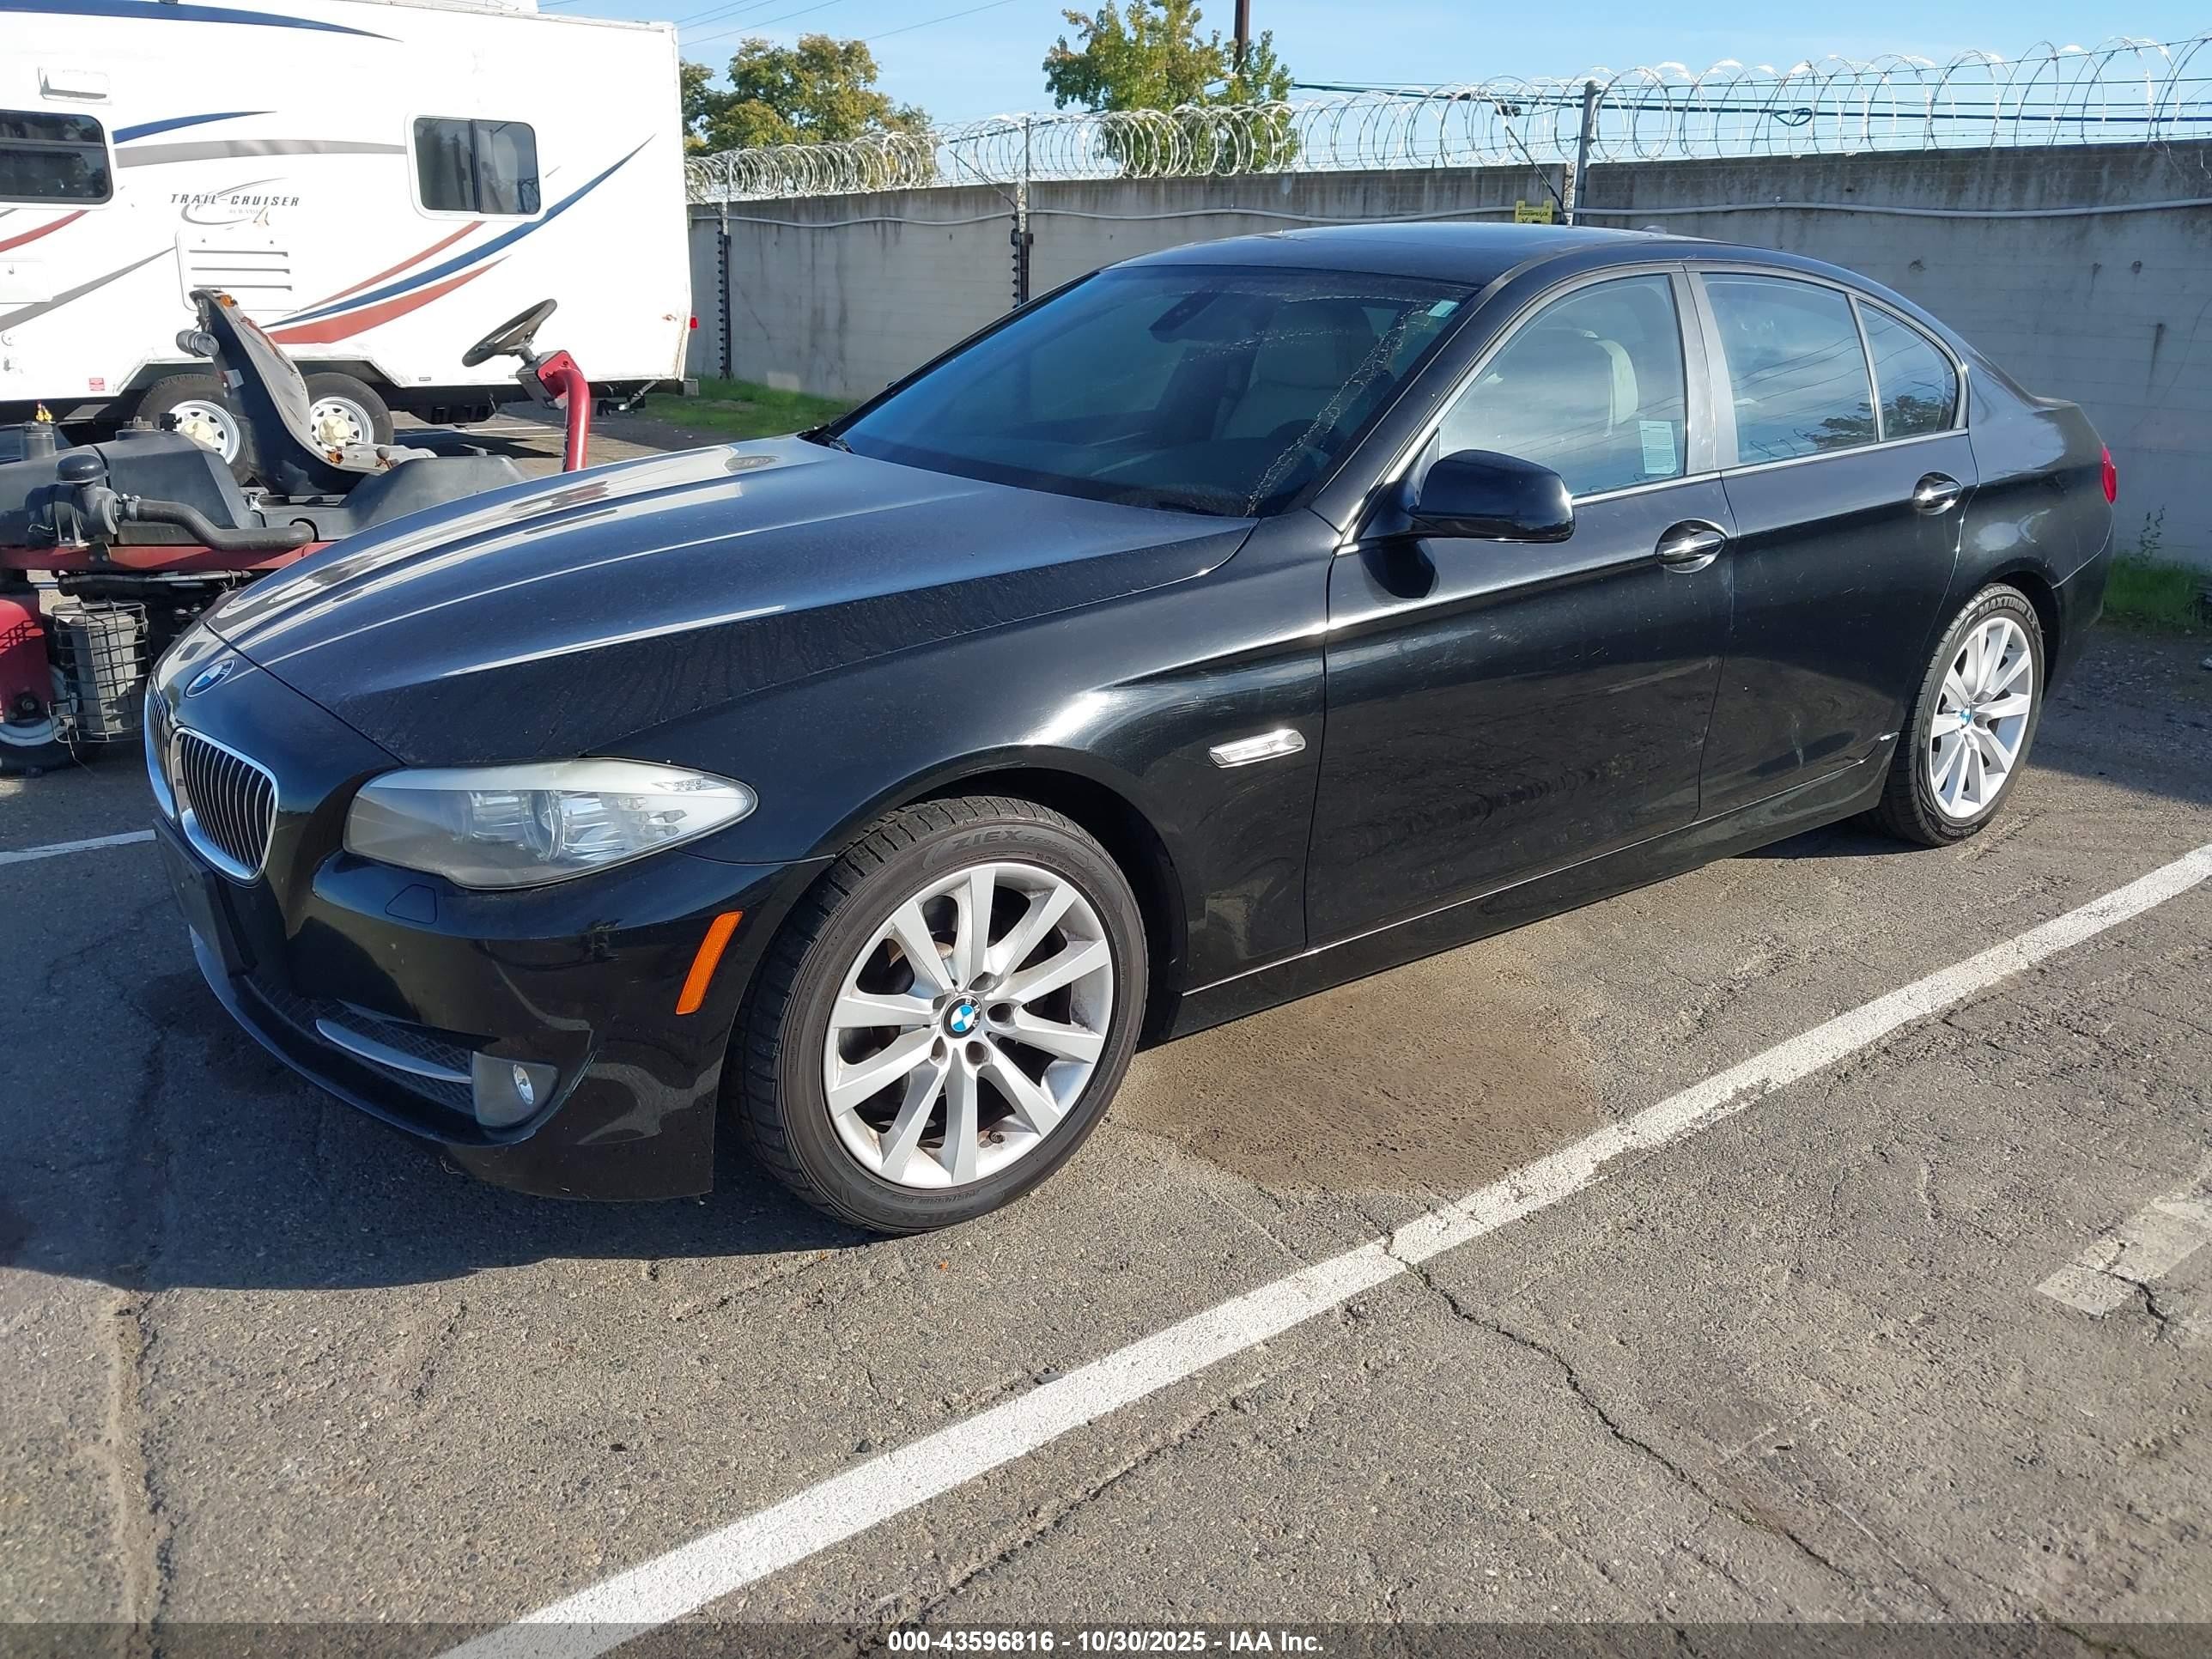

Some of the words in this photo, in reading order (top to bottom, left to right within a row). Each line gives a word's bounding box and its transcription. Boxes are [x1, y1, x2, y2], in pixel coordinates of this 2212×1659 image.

[170, 194, 301, 206] TRAIL-CRUISER
[1978, 596, 2027, 618] MAXTOUR
[2027, 610, 2037, 629] LX
[951, 830, 1023, 848] ZIEX
[964, 997, 981, 1029] BMW
